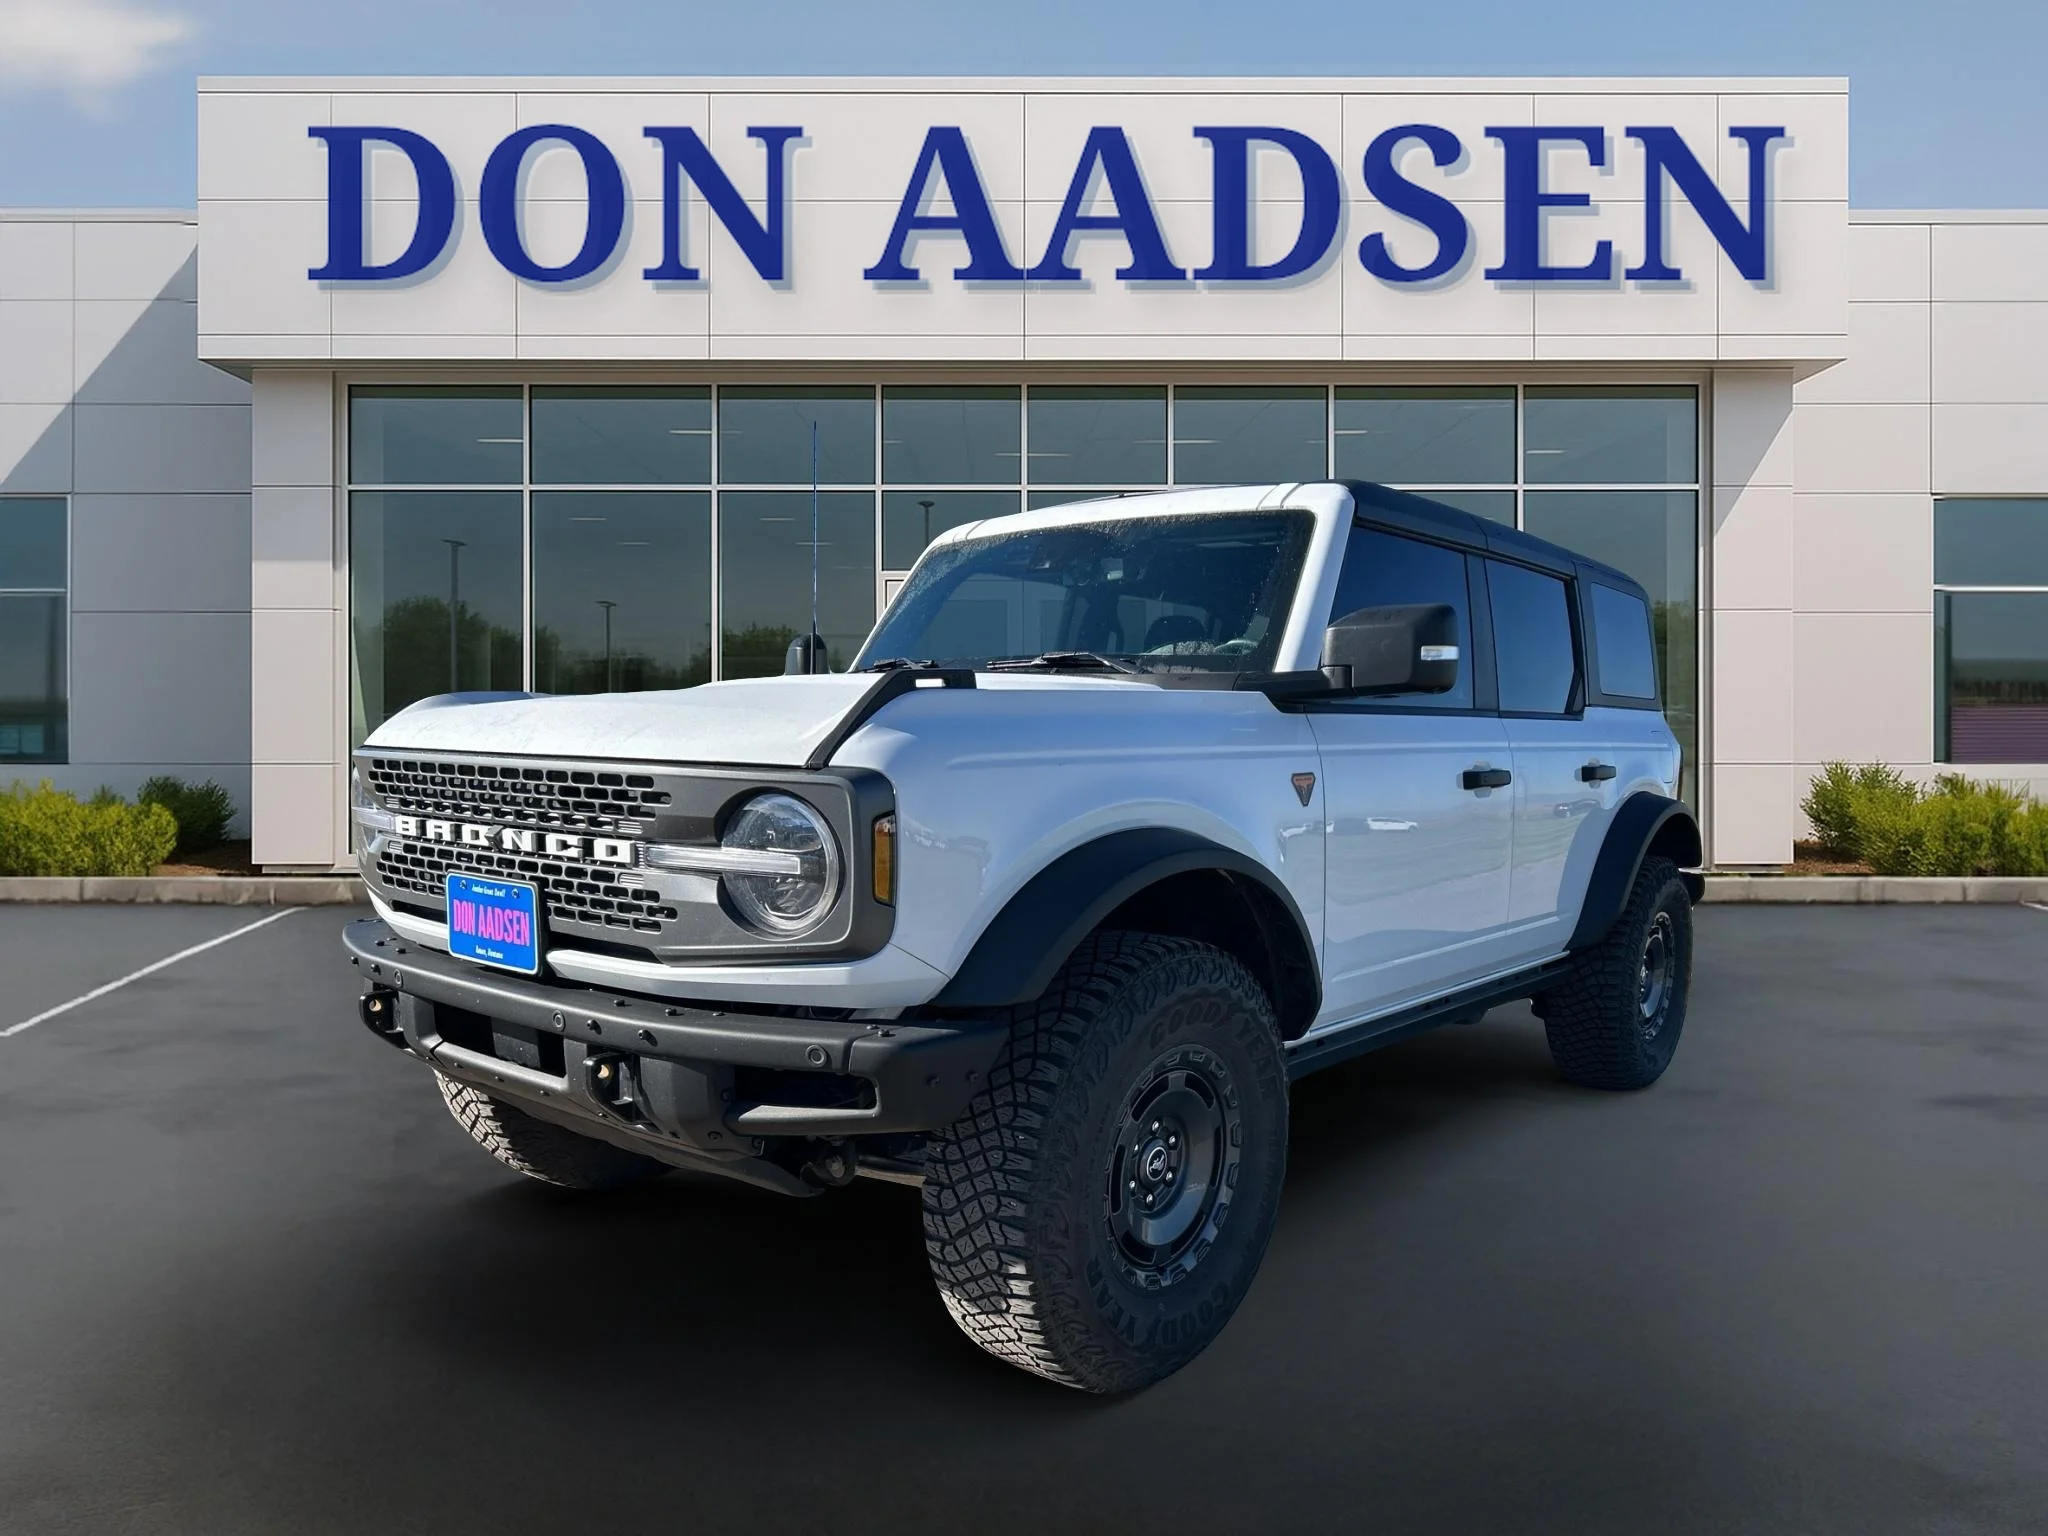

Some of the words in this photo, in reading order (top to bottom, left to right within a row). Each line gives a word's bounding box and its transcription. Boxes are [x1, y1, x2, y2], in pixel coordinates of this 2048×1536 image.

[308, 125, 803, 283] DON
[863, 125, 1785, 283] AADSEN
[394, 814, 637, 864] BRONCO
[453, 899, 475, 936] DON
[478, 904, 530, 947] AADSEN
